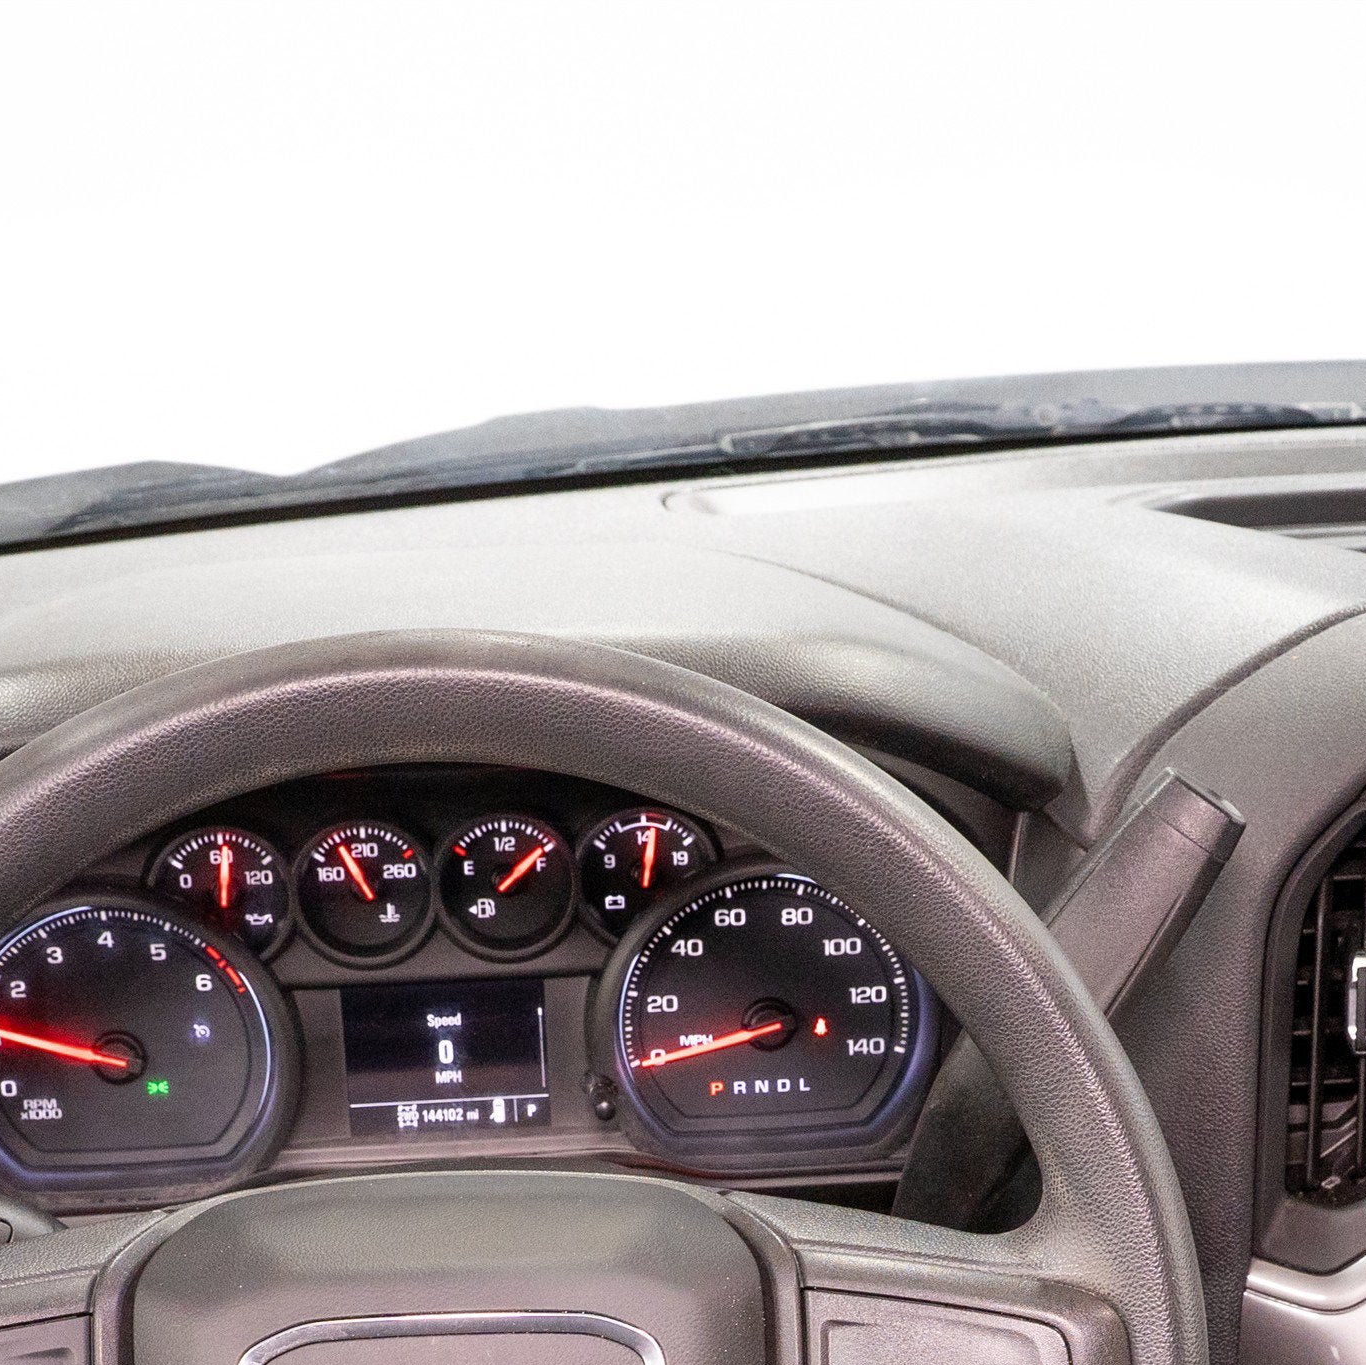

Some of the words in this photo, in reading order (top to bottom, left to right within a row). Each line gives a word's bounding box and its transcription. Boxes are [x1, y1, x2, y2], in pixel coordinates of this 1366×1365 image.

[350, 843, 379, 859] 210
[493, 836, 517, 852] 1/2
[535, 857, 547, 872] F
[603, 854, 617, 869] 9
[672, 851, 689, 867] 19
[317, 866, 346, 883] 160
[382, 863, 417, 879] 260
[463, 861, 475, 876] E
[179, 874, 193, 889] 0
[244, 870, 274, 886] 120
[714, 907, 746, 927] 60
[781, 907, 813, 926] 80
[97, 931, 115, 948] 4
[671, 939, 703, 957] 40
[823, 937, 862, 957] 100
[47, 946, 64, 964] 3
[150, 944, 167, 961] 5
[10, 981, 27, 999] 2
[195, 973, 213, 992] 6
[849, 985, 887, 1004] 120
[647, 995, 678, 1013] 20
[426, 1013, 462, 1028] Speed
[679, 1034, 714, 1047] MPH
[846, 1038, 886, 1056] 140
[438, 1039, 454, 1064] 0
[435, 1071, 462, 1084] MPH
[0, 1080, 18, 1098] 0
[710, 1082, 724, 1096] P
[733, 1081, 746, 1095] R
[754, 1079, 770, 1094] N
[776, 1078, 791, 1093] D
[799, 1078, 811, 1092] L
[23, 1098, 58, 1110] RPM
[527, 1103, 537, 1118] P
[421, 1107, 464, 1122] 144102
[466, 1108, 480, 1120] mi
